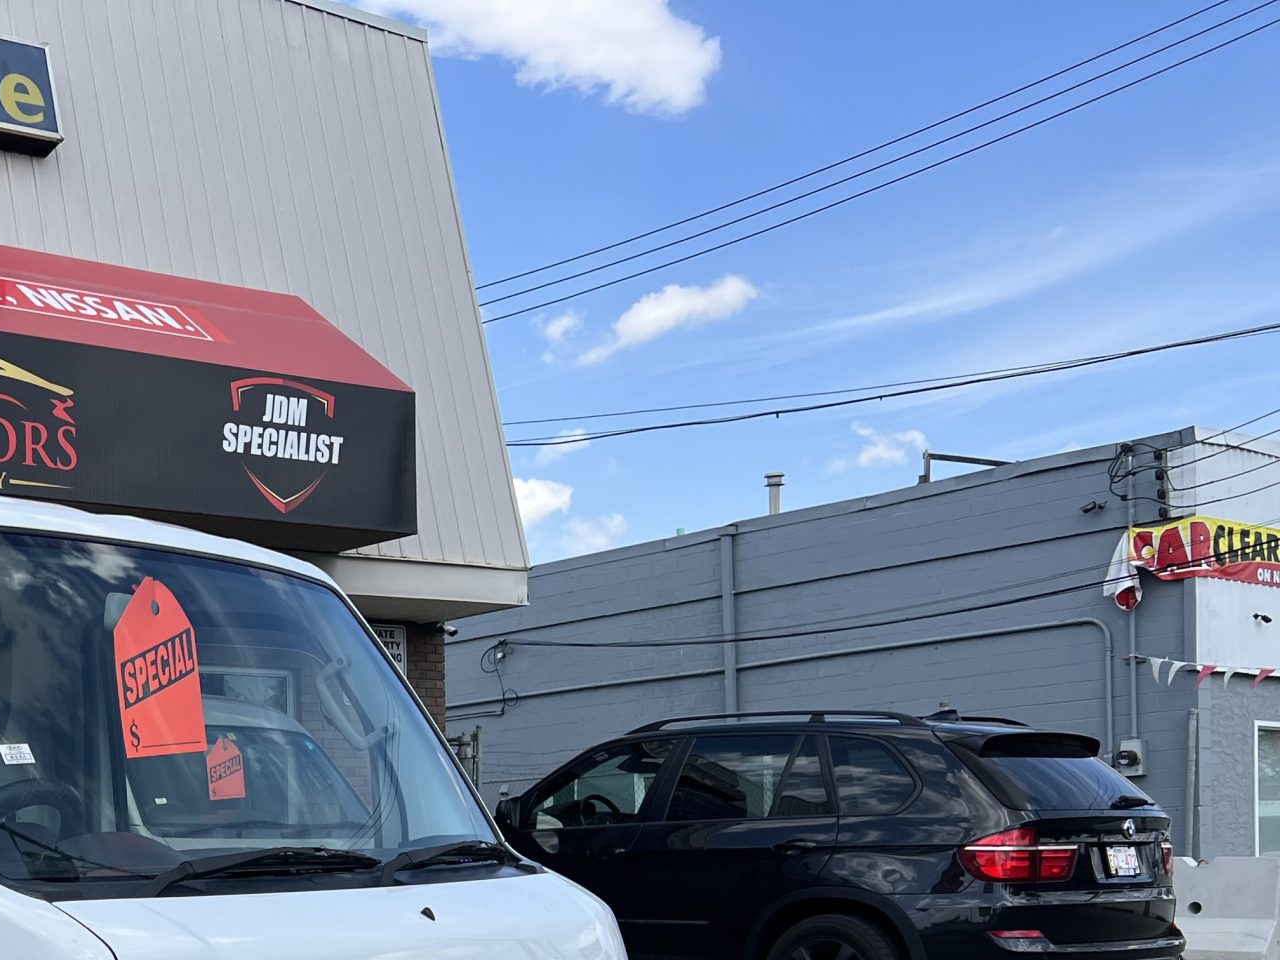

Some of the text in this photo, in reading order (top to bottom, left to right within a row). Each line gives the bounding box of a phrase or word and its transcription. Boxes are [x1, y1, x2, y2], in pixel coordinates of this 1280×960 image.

[262, 393, 309, 427] JDM
[222, 422, 344, 465] SPECIALIST
[1133, 522, 1212, 568] CAR
[124, 632, 193, 704] SPECIAL
[129, 719, 141, 752] $
[210, 756, 241, 782] SPECIAL
